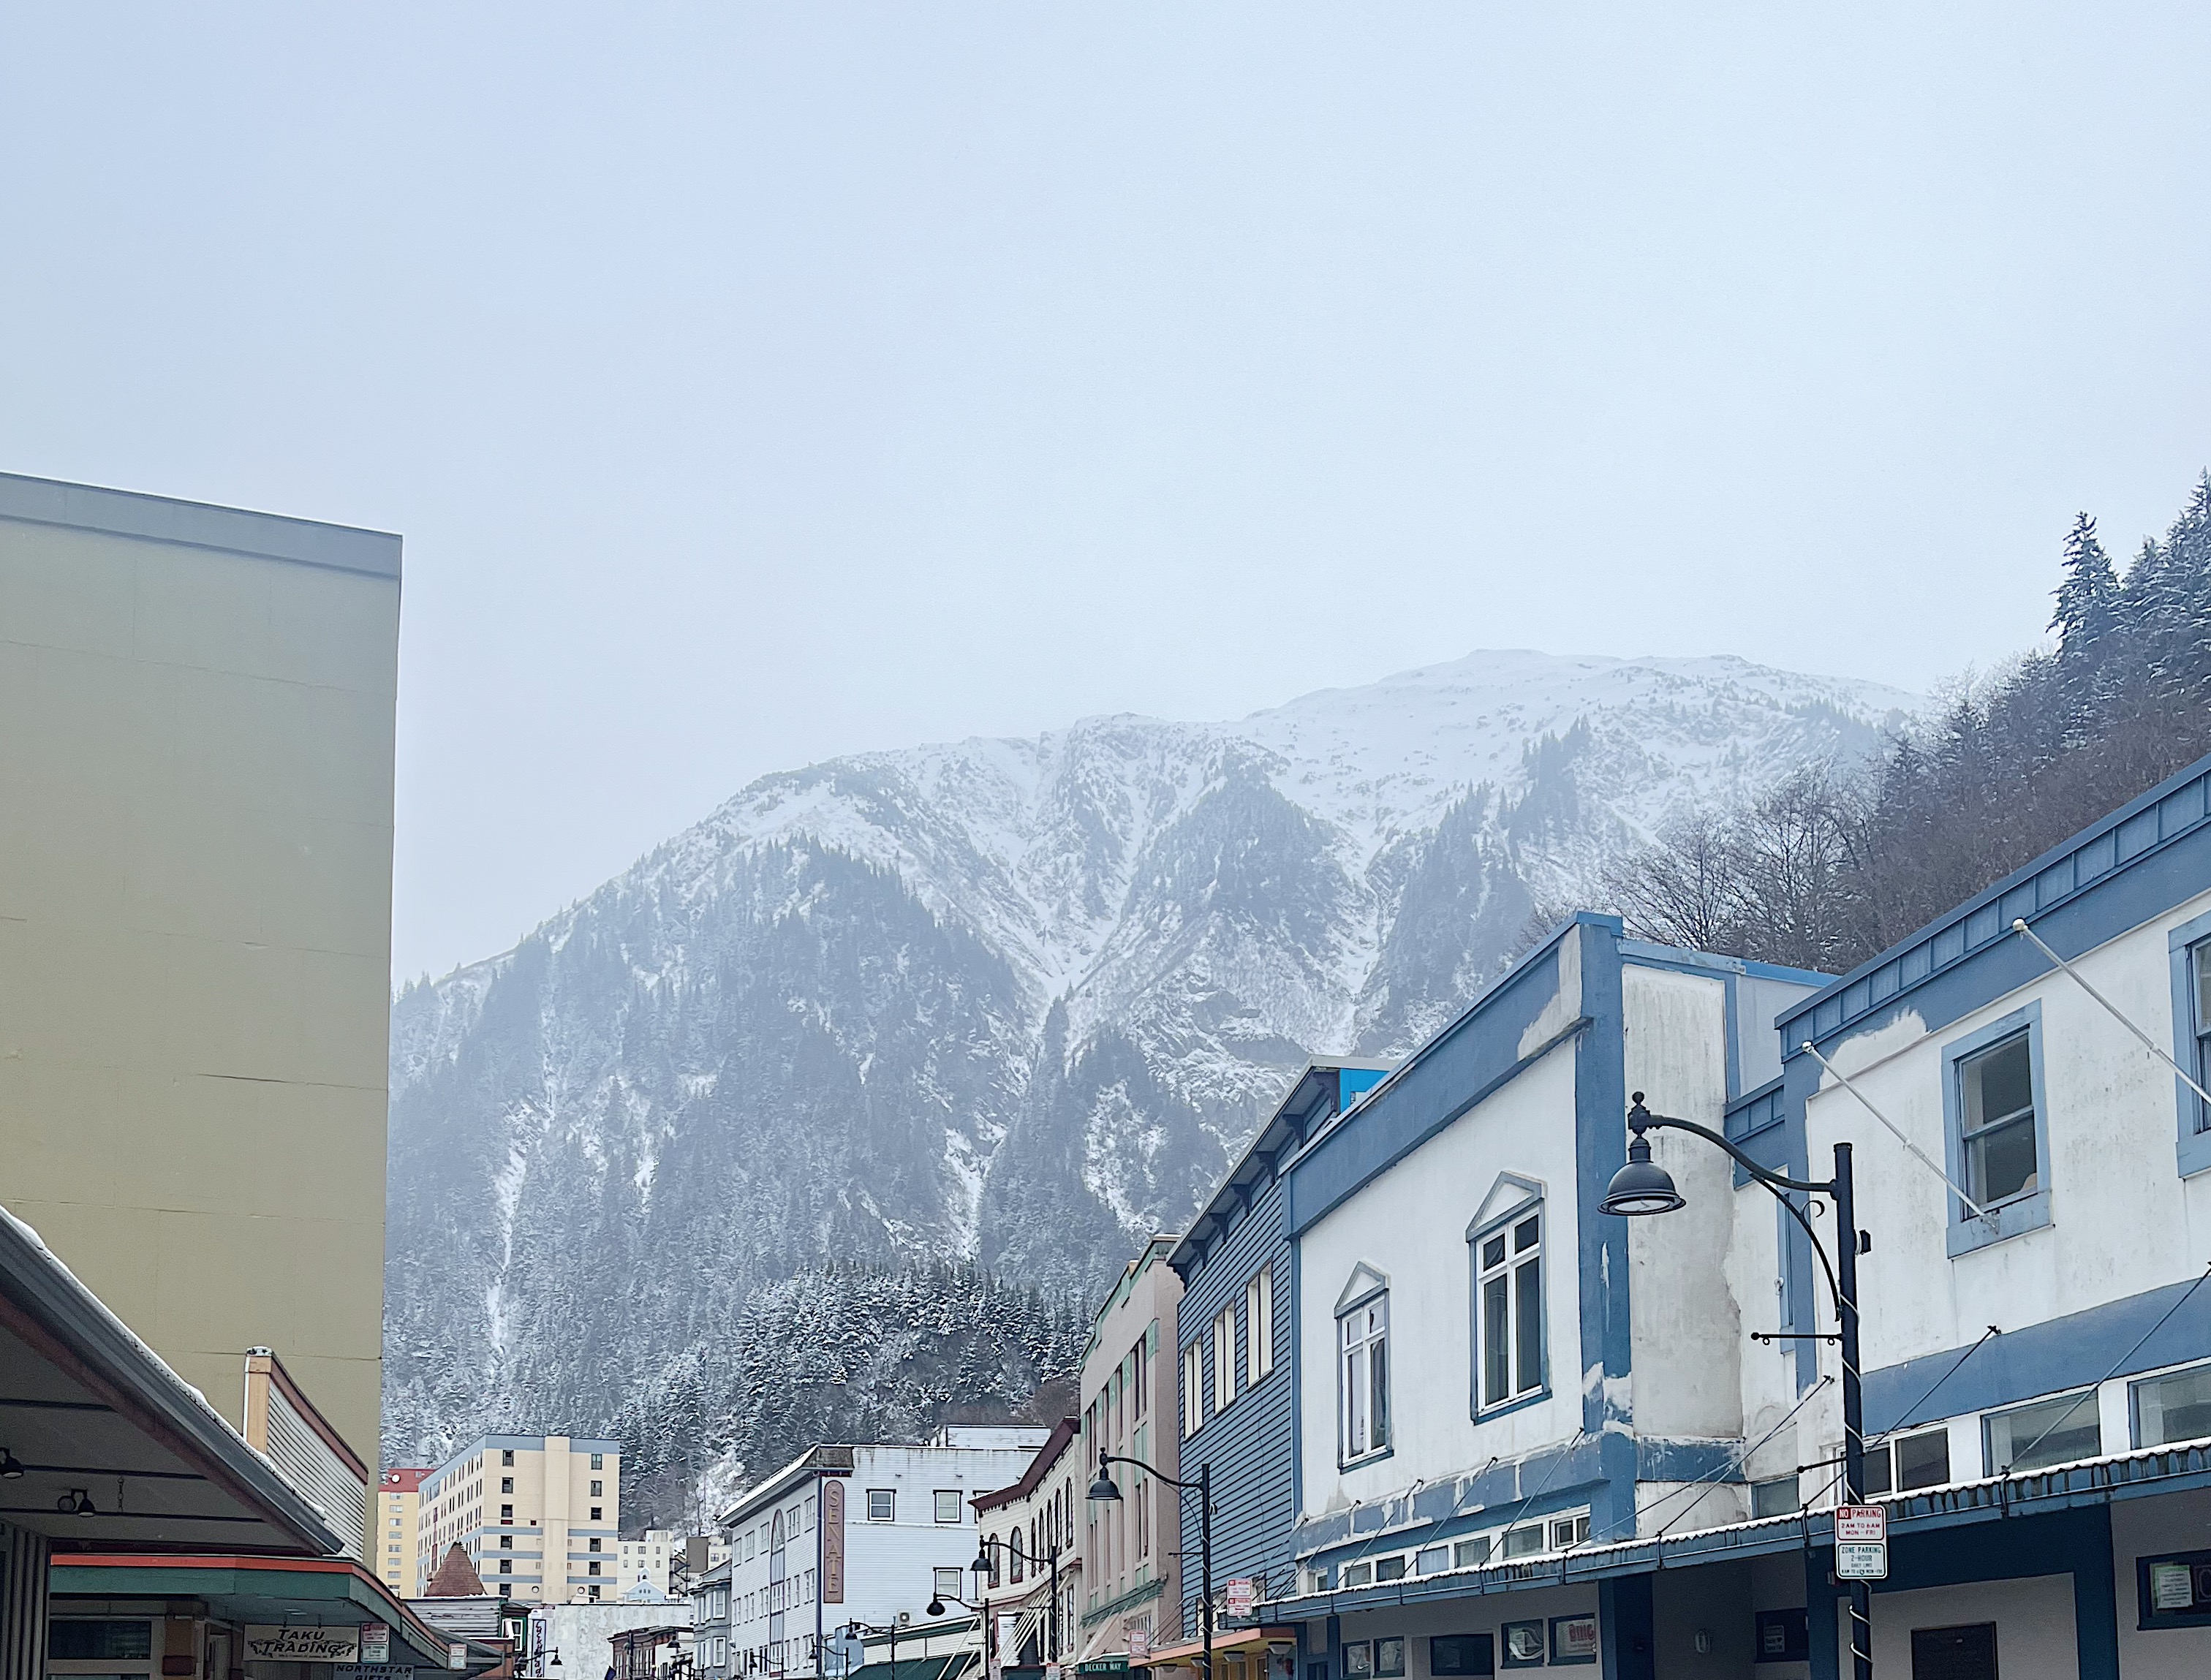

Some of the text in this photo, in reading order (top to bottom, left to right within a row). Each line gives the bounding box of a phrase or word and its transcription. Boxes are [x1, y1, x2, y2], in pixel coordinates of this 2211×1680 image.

[1839, 1509, 1881, 1518] NO PARKING
[825, 1491, 842, 1594] SENATE
[279, 1629, 325, 1641] TAKU
[263, 1641, 340, 1654] TRADING
[336, 1665, 412, 1674] NORTHSTAR
[1084, 1662, 1122, 1672] DECKER WAY
